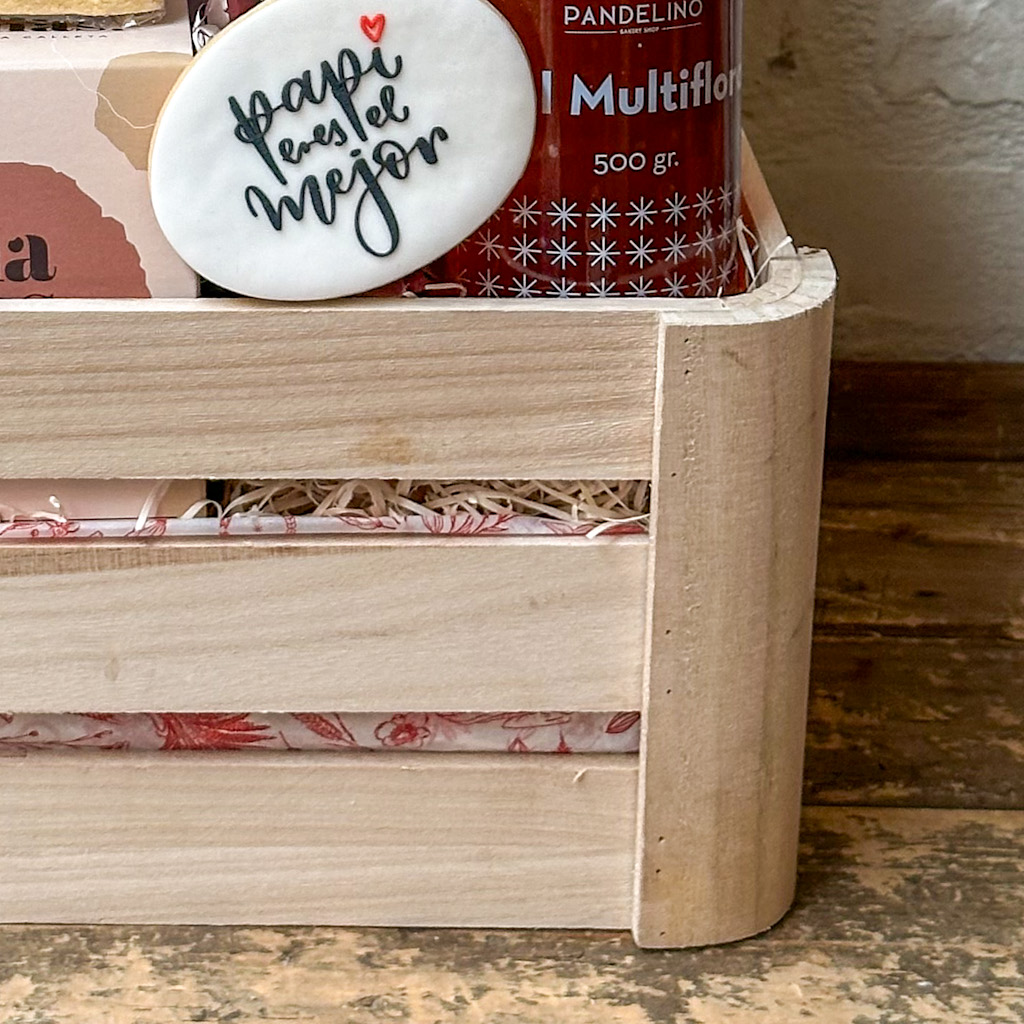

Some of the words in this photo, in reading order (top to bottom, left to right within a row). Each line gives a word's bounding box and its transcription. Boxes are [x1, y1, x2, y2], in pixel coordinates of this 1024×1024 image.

[228, 47, 403, 186] papi
[278, 117, 347, 165] eres
[365, 85, 410, 129] el
[593, 152, 647, 175] 500
[652, 151, 680, 176] gr.
[244, 125, 449, 258] mejor
